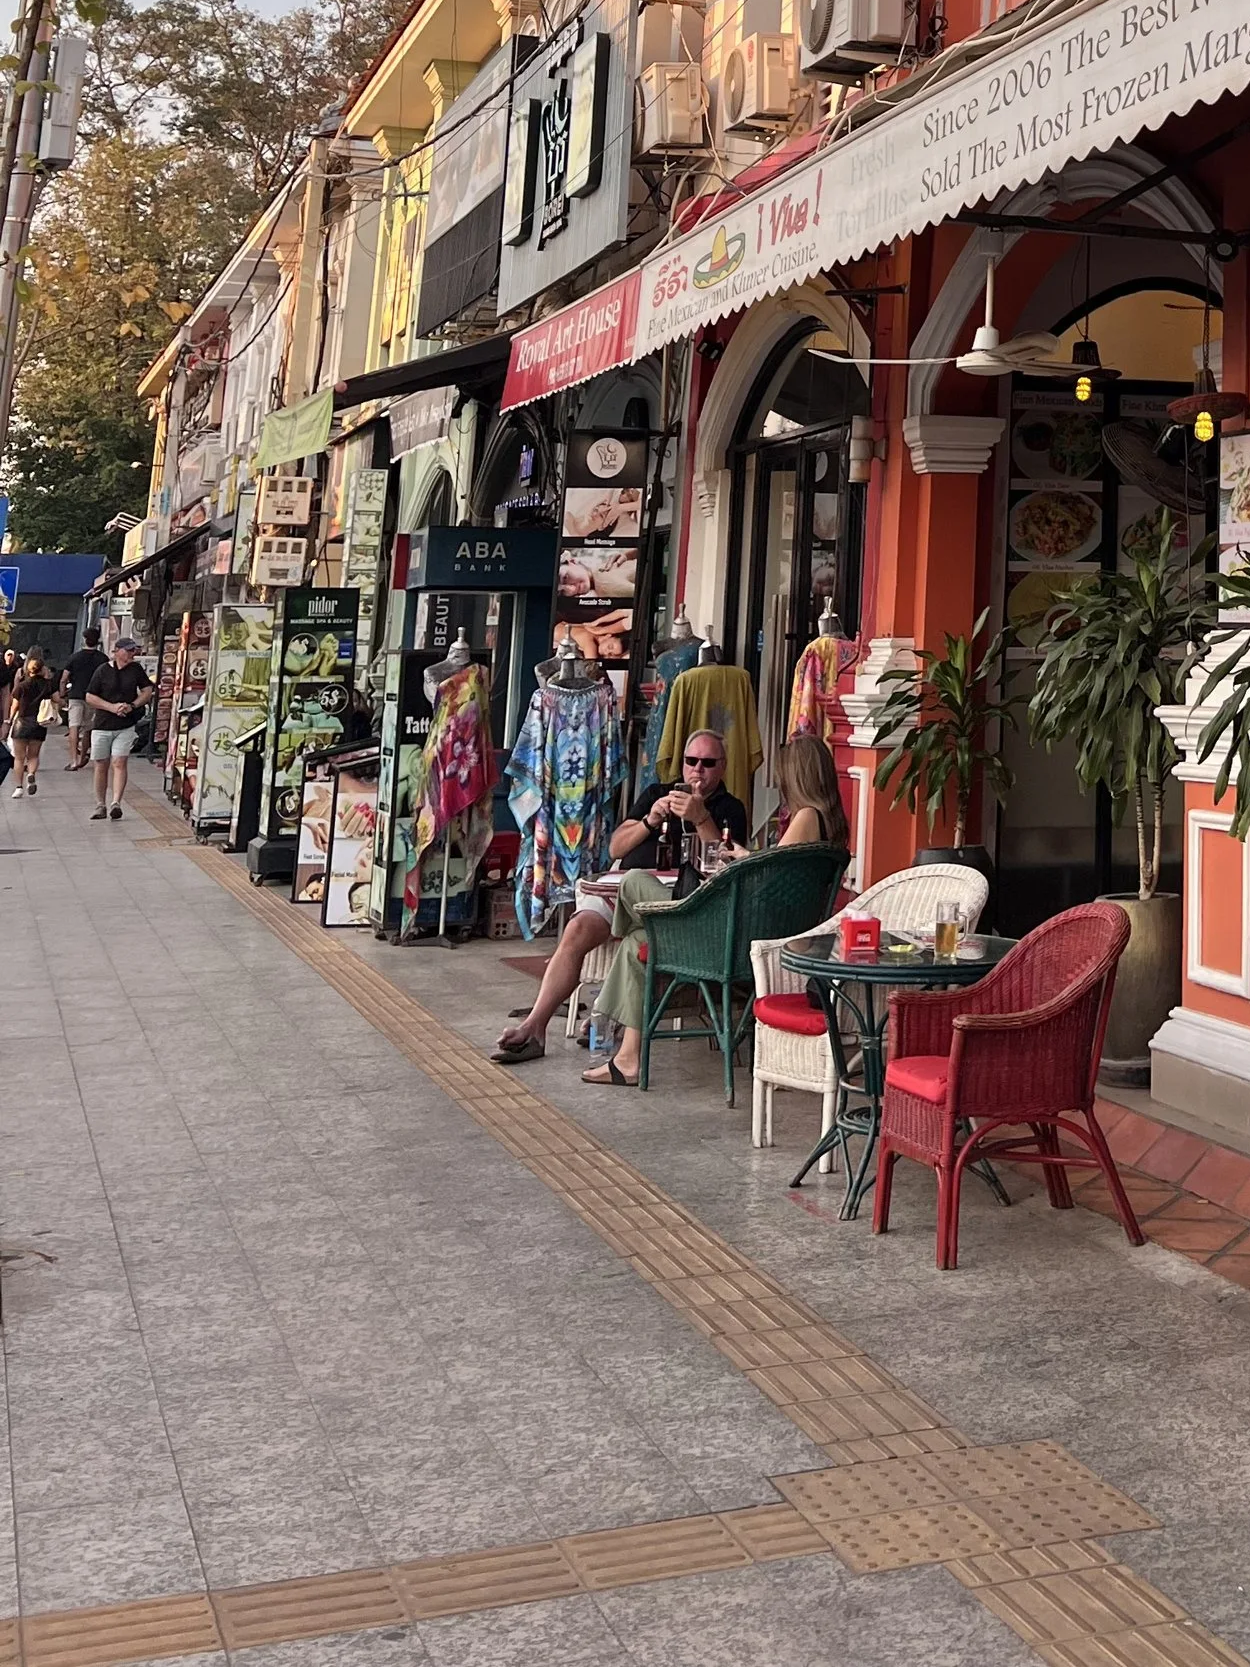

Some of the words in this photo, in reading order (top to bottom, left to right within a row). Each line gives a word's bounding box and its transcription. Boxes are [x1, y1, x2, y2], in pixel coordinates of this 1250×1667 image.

[922, 96, 980, 149] Since
[987, 49, 1052, 116] 2006
[1061, 26, 1110, 78] The
[921, 152, 962, 204] Sold
[968, 135, 1007, 181] The
[1013, 103, 1074, 160] Most
[1080, 61, 1170, 130] Frozen
[850, 134, 896, 186] Fresh
[648, 310, 666, 340] Fine
[667, 291, 709, 332] Mexican
[710, 280, 731, 307] and
[731, 260, 770, 298] Khmer
[771, 239, 819, 281] Cuisine.
[516, 324, 552, 375] Royal
[551, 318, 575, 356] Art
[575, 298, 621, 346] House
[1144, 401, 1167, 413] Khm
[454, 563, 507, 572] BANK
[455, 541, 508, 559] ABA
[308, 596, 338, 616] pidor
[433, 595, 450, 647] BEAUT
